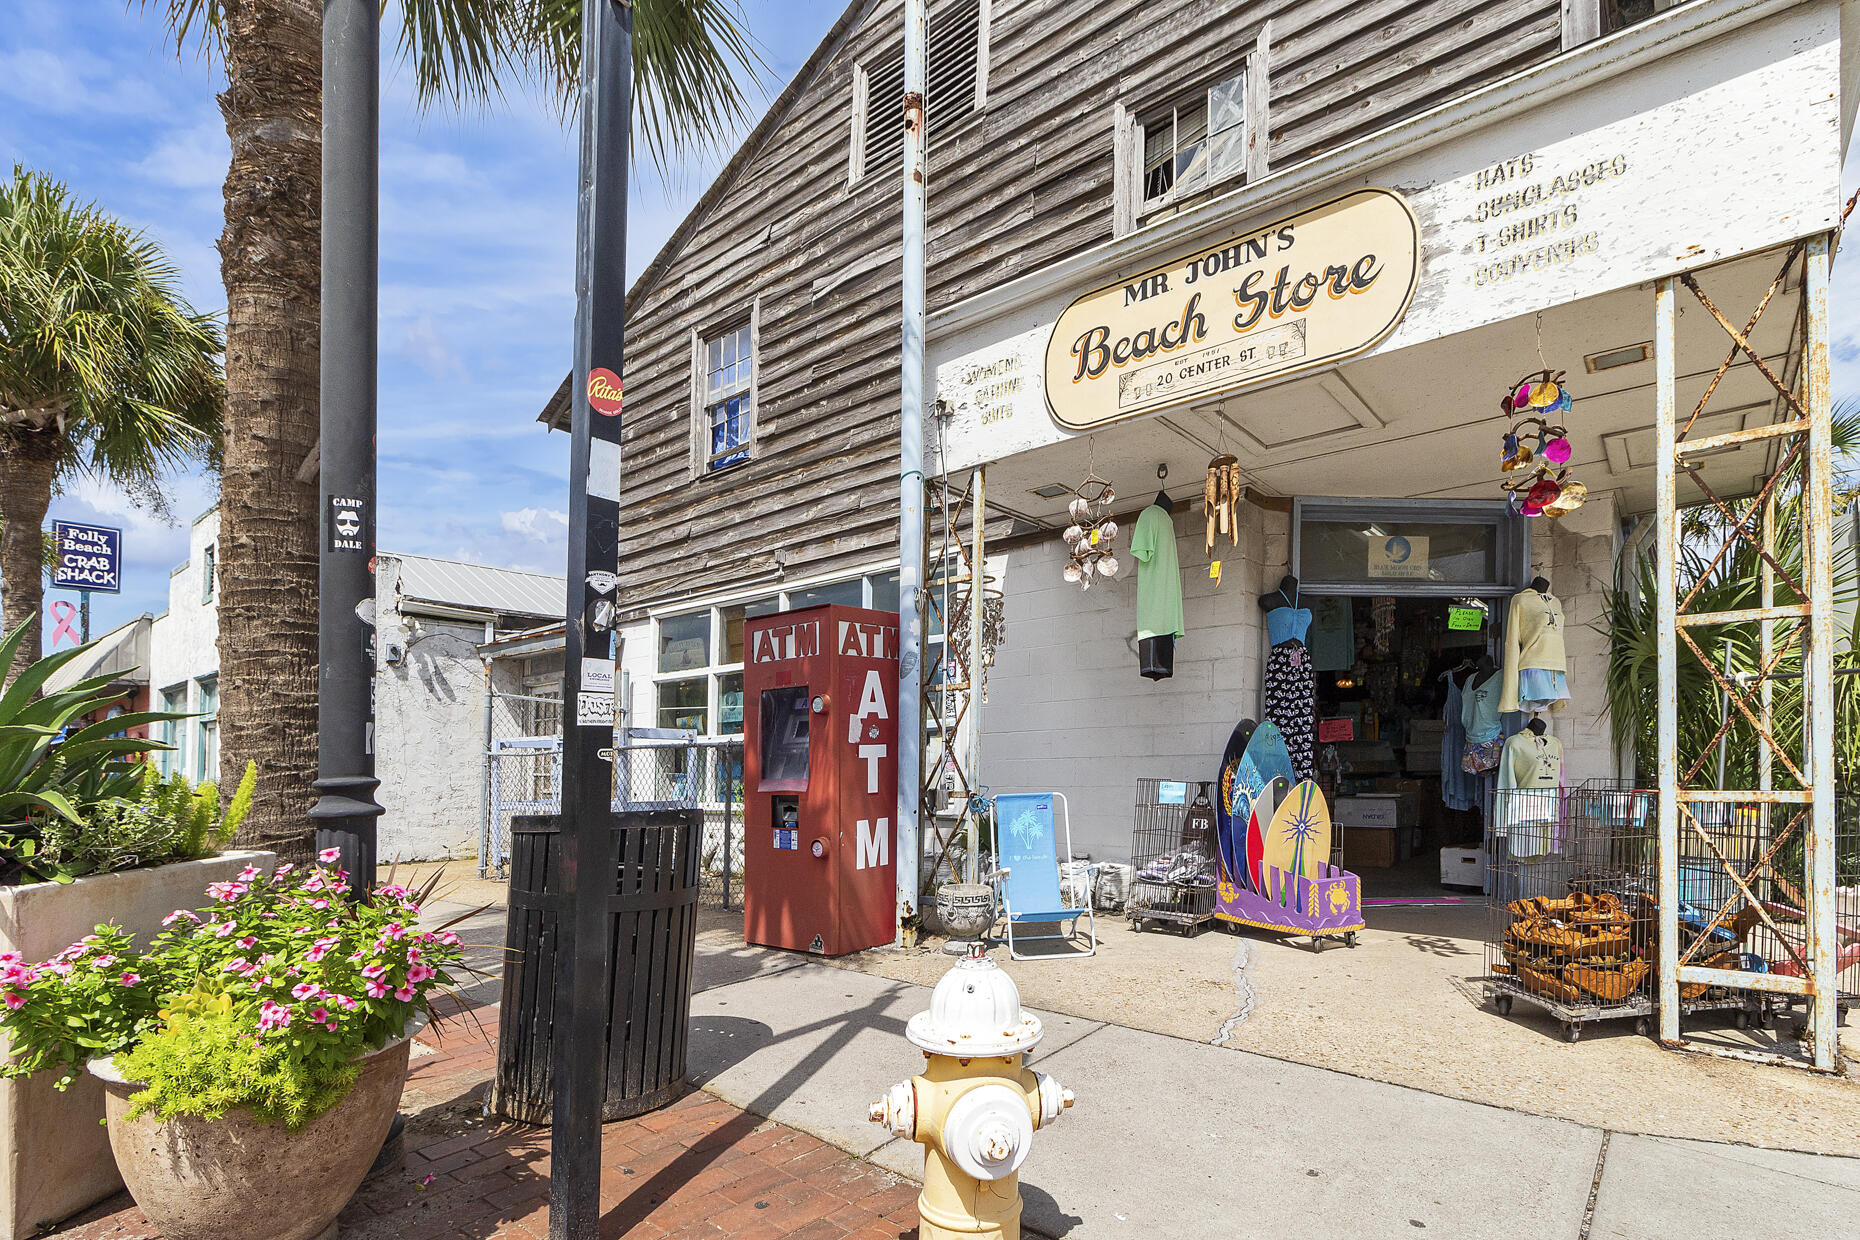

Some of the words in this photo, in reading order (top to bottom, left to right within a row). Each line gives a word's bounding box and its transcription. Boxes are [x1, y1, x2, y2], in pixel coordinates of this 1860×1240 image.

[1475, 153, 1534, 192] HATS
[1476, 153, 1628, 223] SUNGLASSES
[1476, 203, 1578, 254] T-SHIRTS
[1122, 272, 1174, 307] MR.
[1184, 223, 1296, 285] JOHN'S
[1070, 291, 1210, 384] Beach
[1231, 253, 1386, 332] Store
[1156, 372, 1173, 387] 20
[1179, 355, 1230, 379] CENTER
[588, 375, 623, 402] Rita's
[332, 497, 363, 508] CAMP
[62, 538, 113, 555] Beach
[67, 528, 109, 545] Folly
[334, 539, 362, 549] DALE
[57, 567, 116, 585] SHACK
[63, 554, 110, 571] CRAB
[1454, 608, 1475, 616] PLEASE
[756, 622, 818, 663] ATM
[841, 622, 899, 660] ATM
[587, 672, 613, 680] LOCAL
[856, 670, 888, 870] ATM
[1192, 818, 1209, 830] FB
